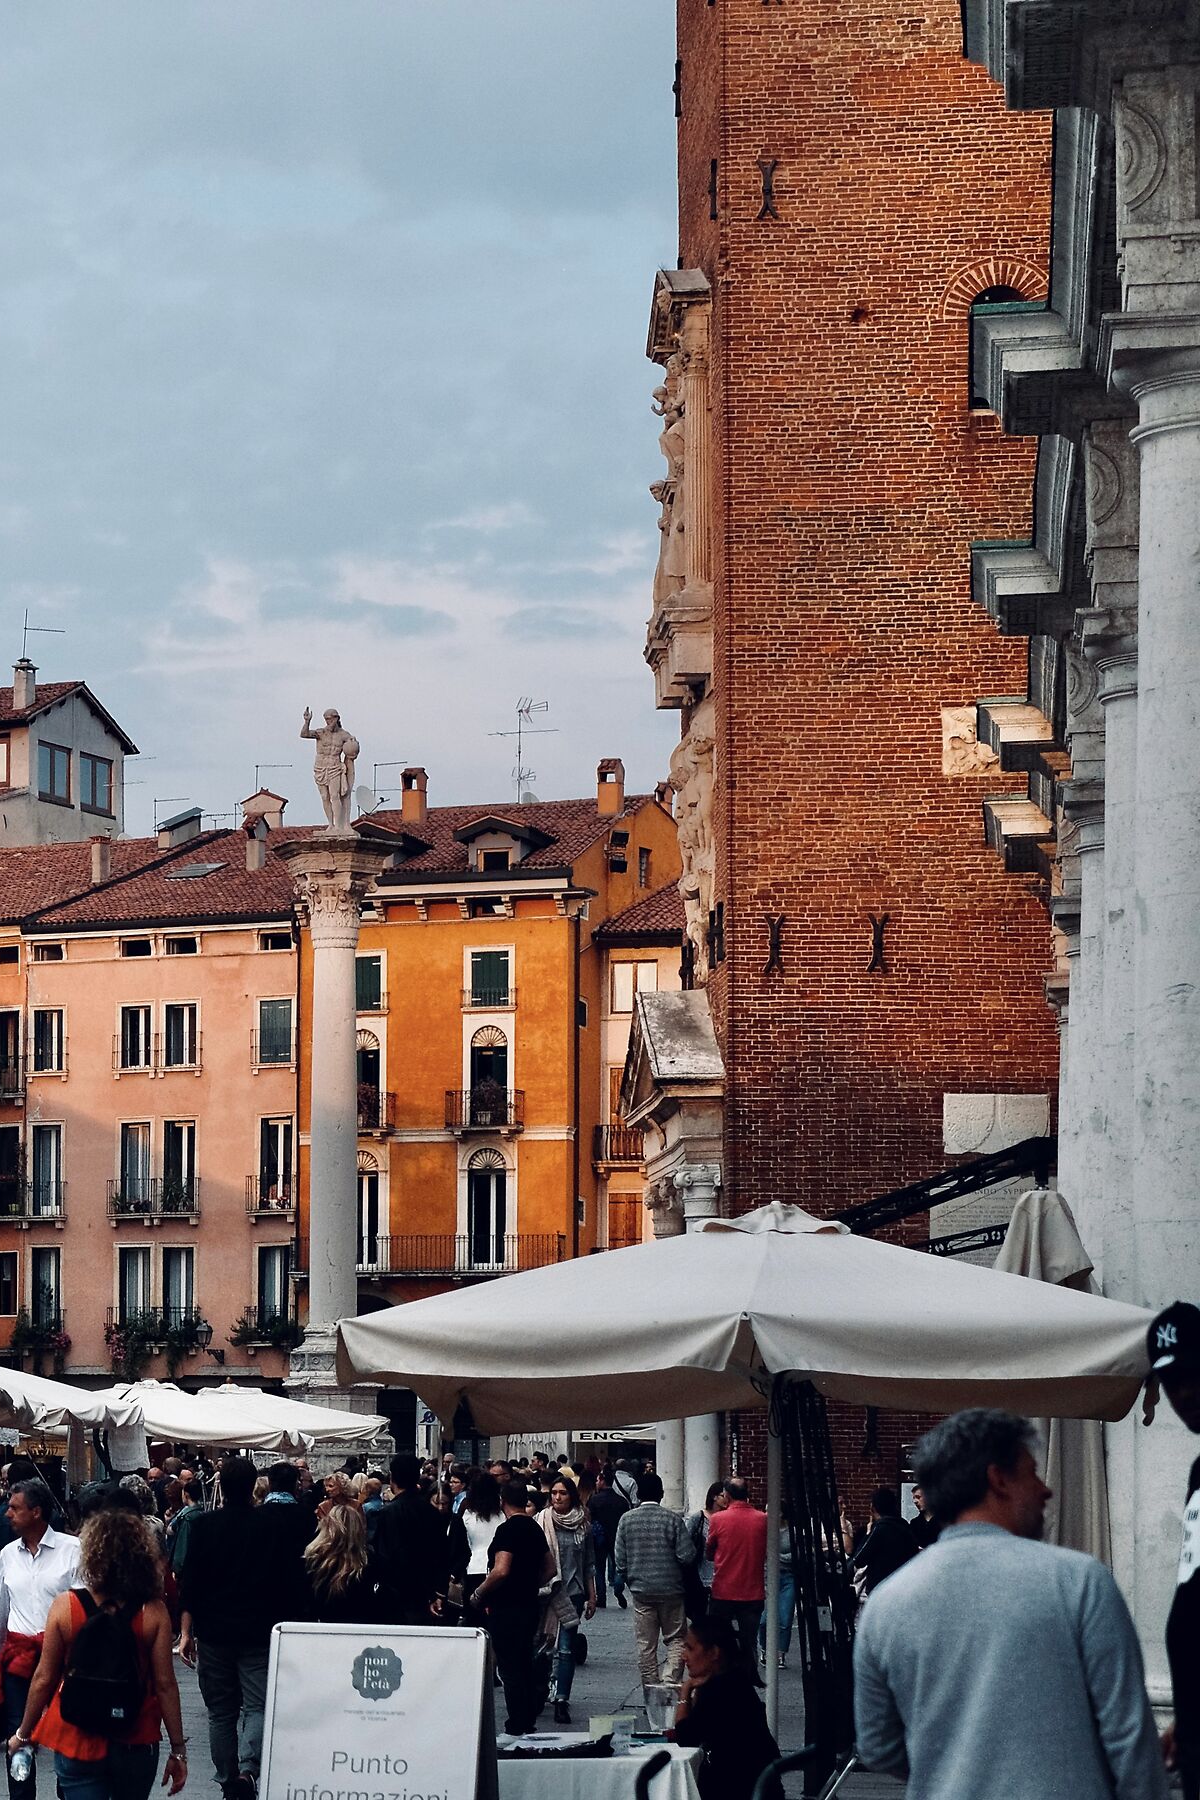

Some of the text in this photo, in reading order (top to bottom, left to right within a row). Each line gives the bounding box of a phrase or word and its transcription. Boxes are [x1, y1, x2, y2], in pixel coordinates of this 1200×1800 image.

[364, 1657, 388, 1665] non
[364, 1665, 380, 1677] ho
[331, 1751, 408, 1775] Punto
